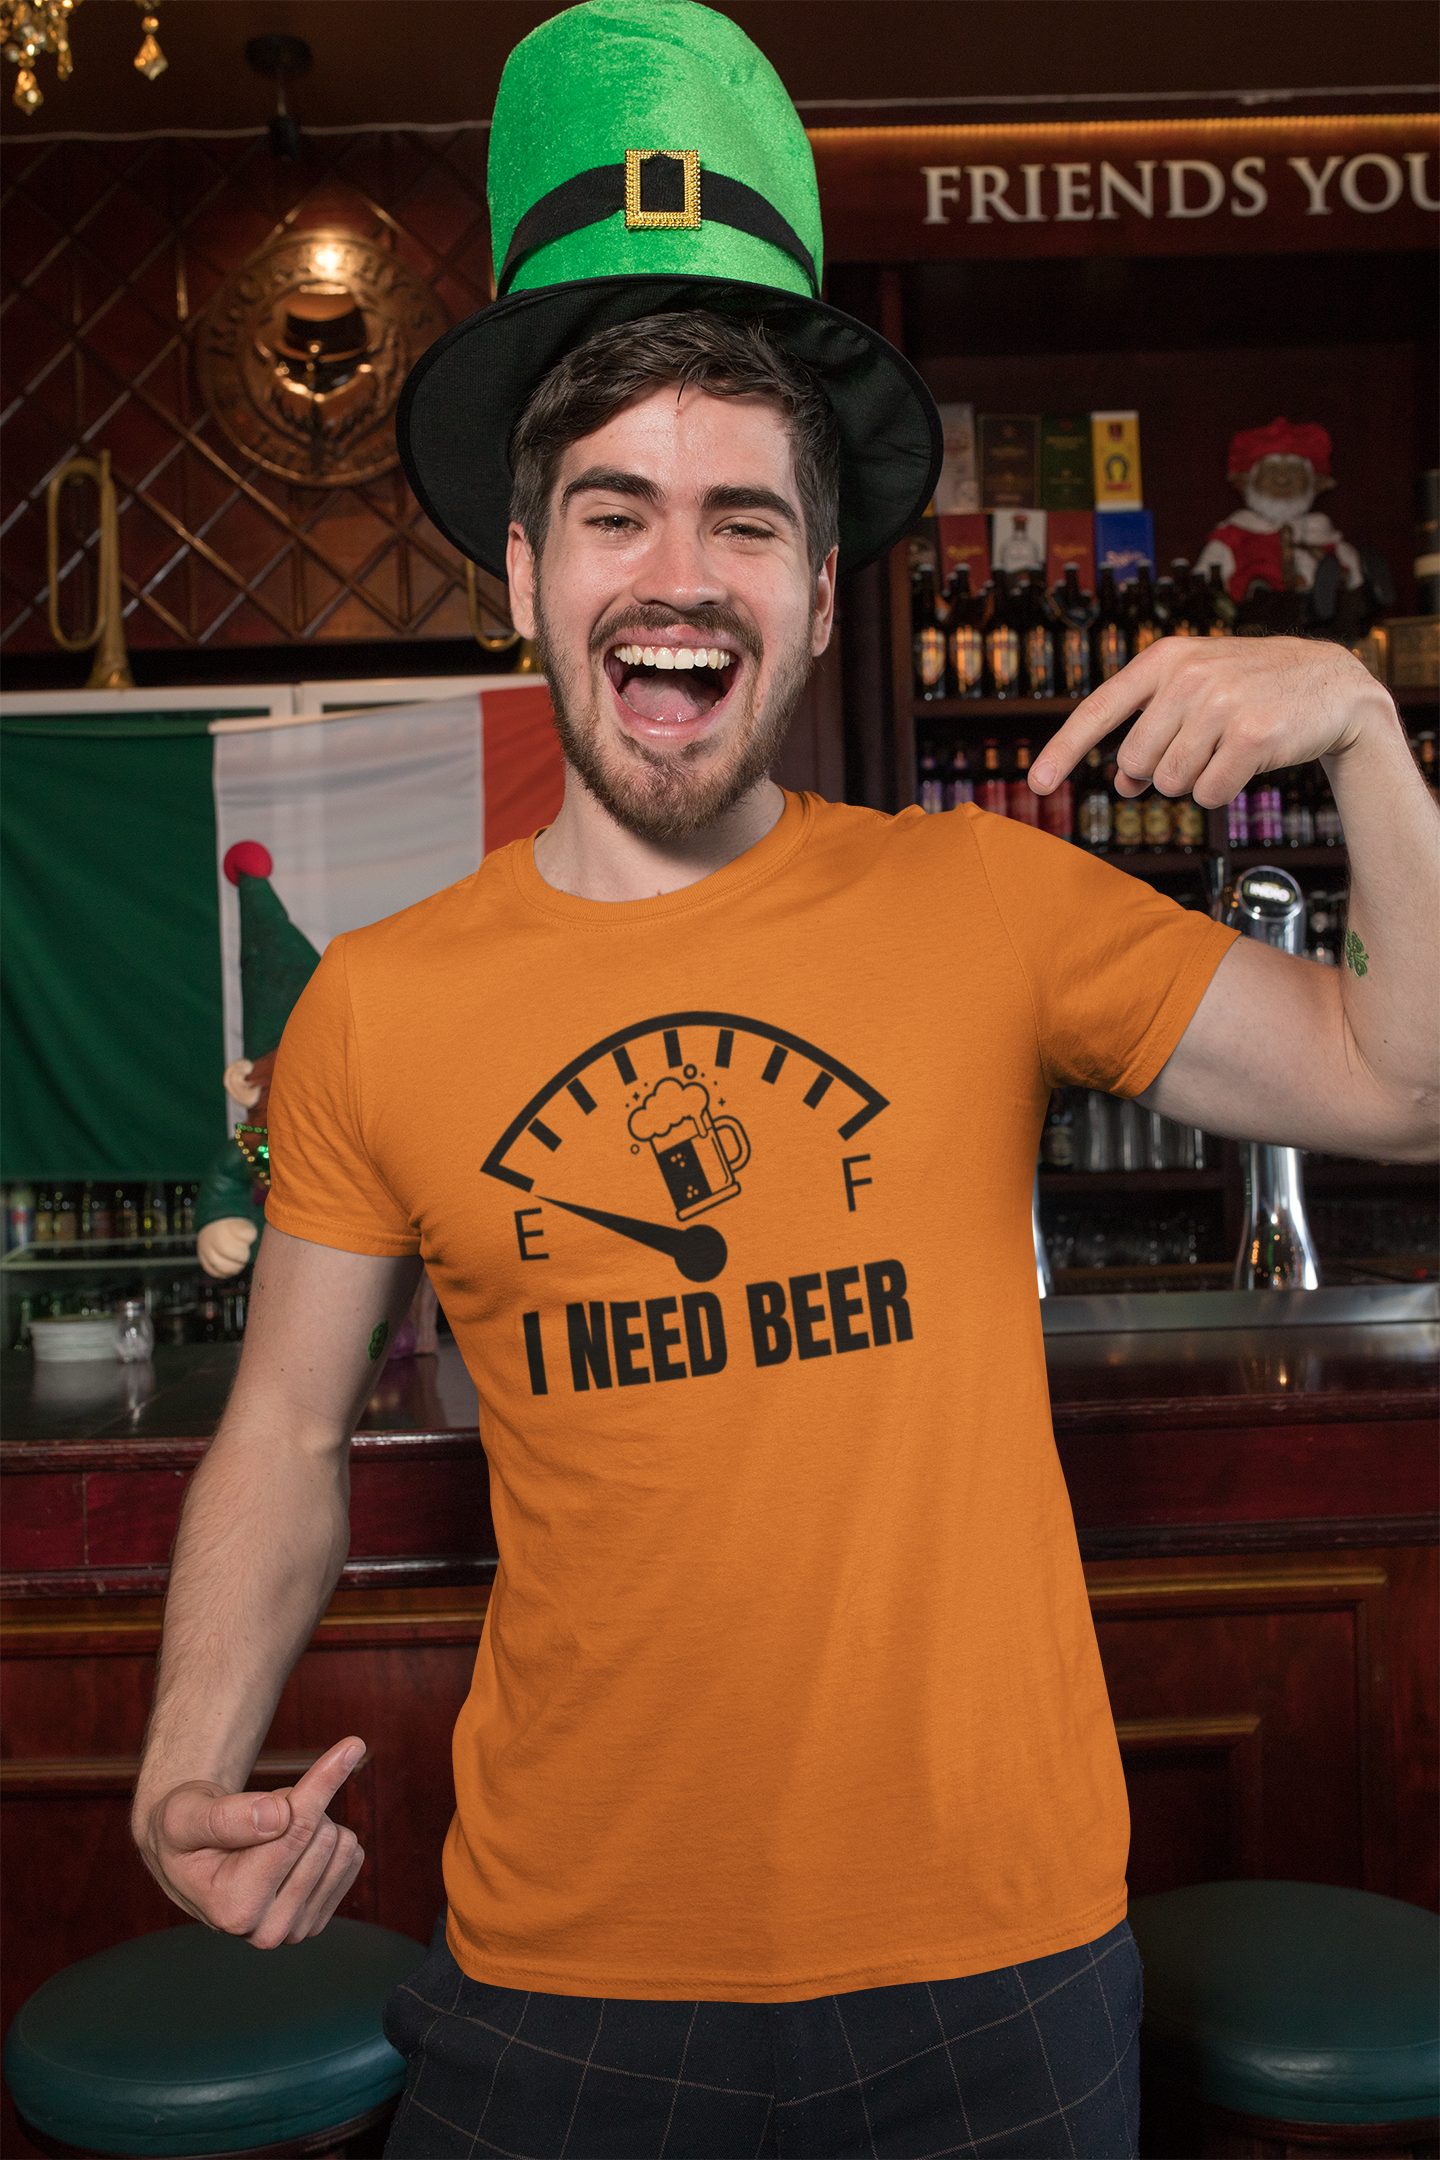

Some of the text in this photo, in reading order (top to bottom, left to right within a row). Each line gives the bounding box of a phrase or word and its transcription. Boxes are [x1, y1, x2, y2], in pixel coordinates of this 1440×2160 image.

[921, 157, 1268, 225] FRIENDS
[842, 1153, 873, 1213] F
[513, 1207, 550, 1262] E
[522, 1258, 914, 1396] I NEED BEER
